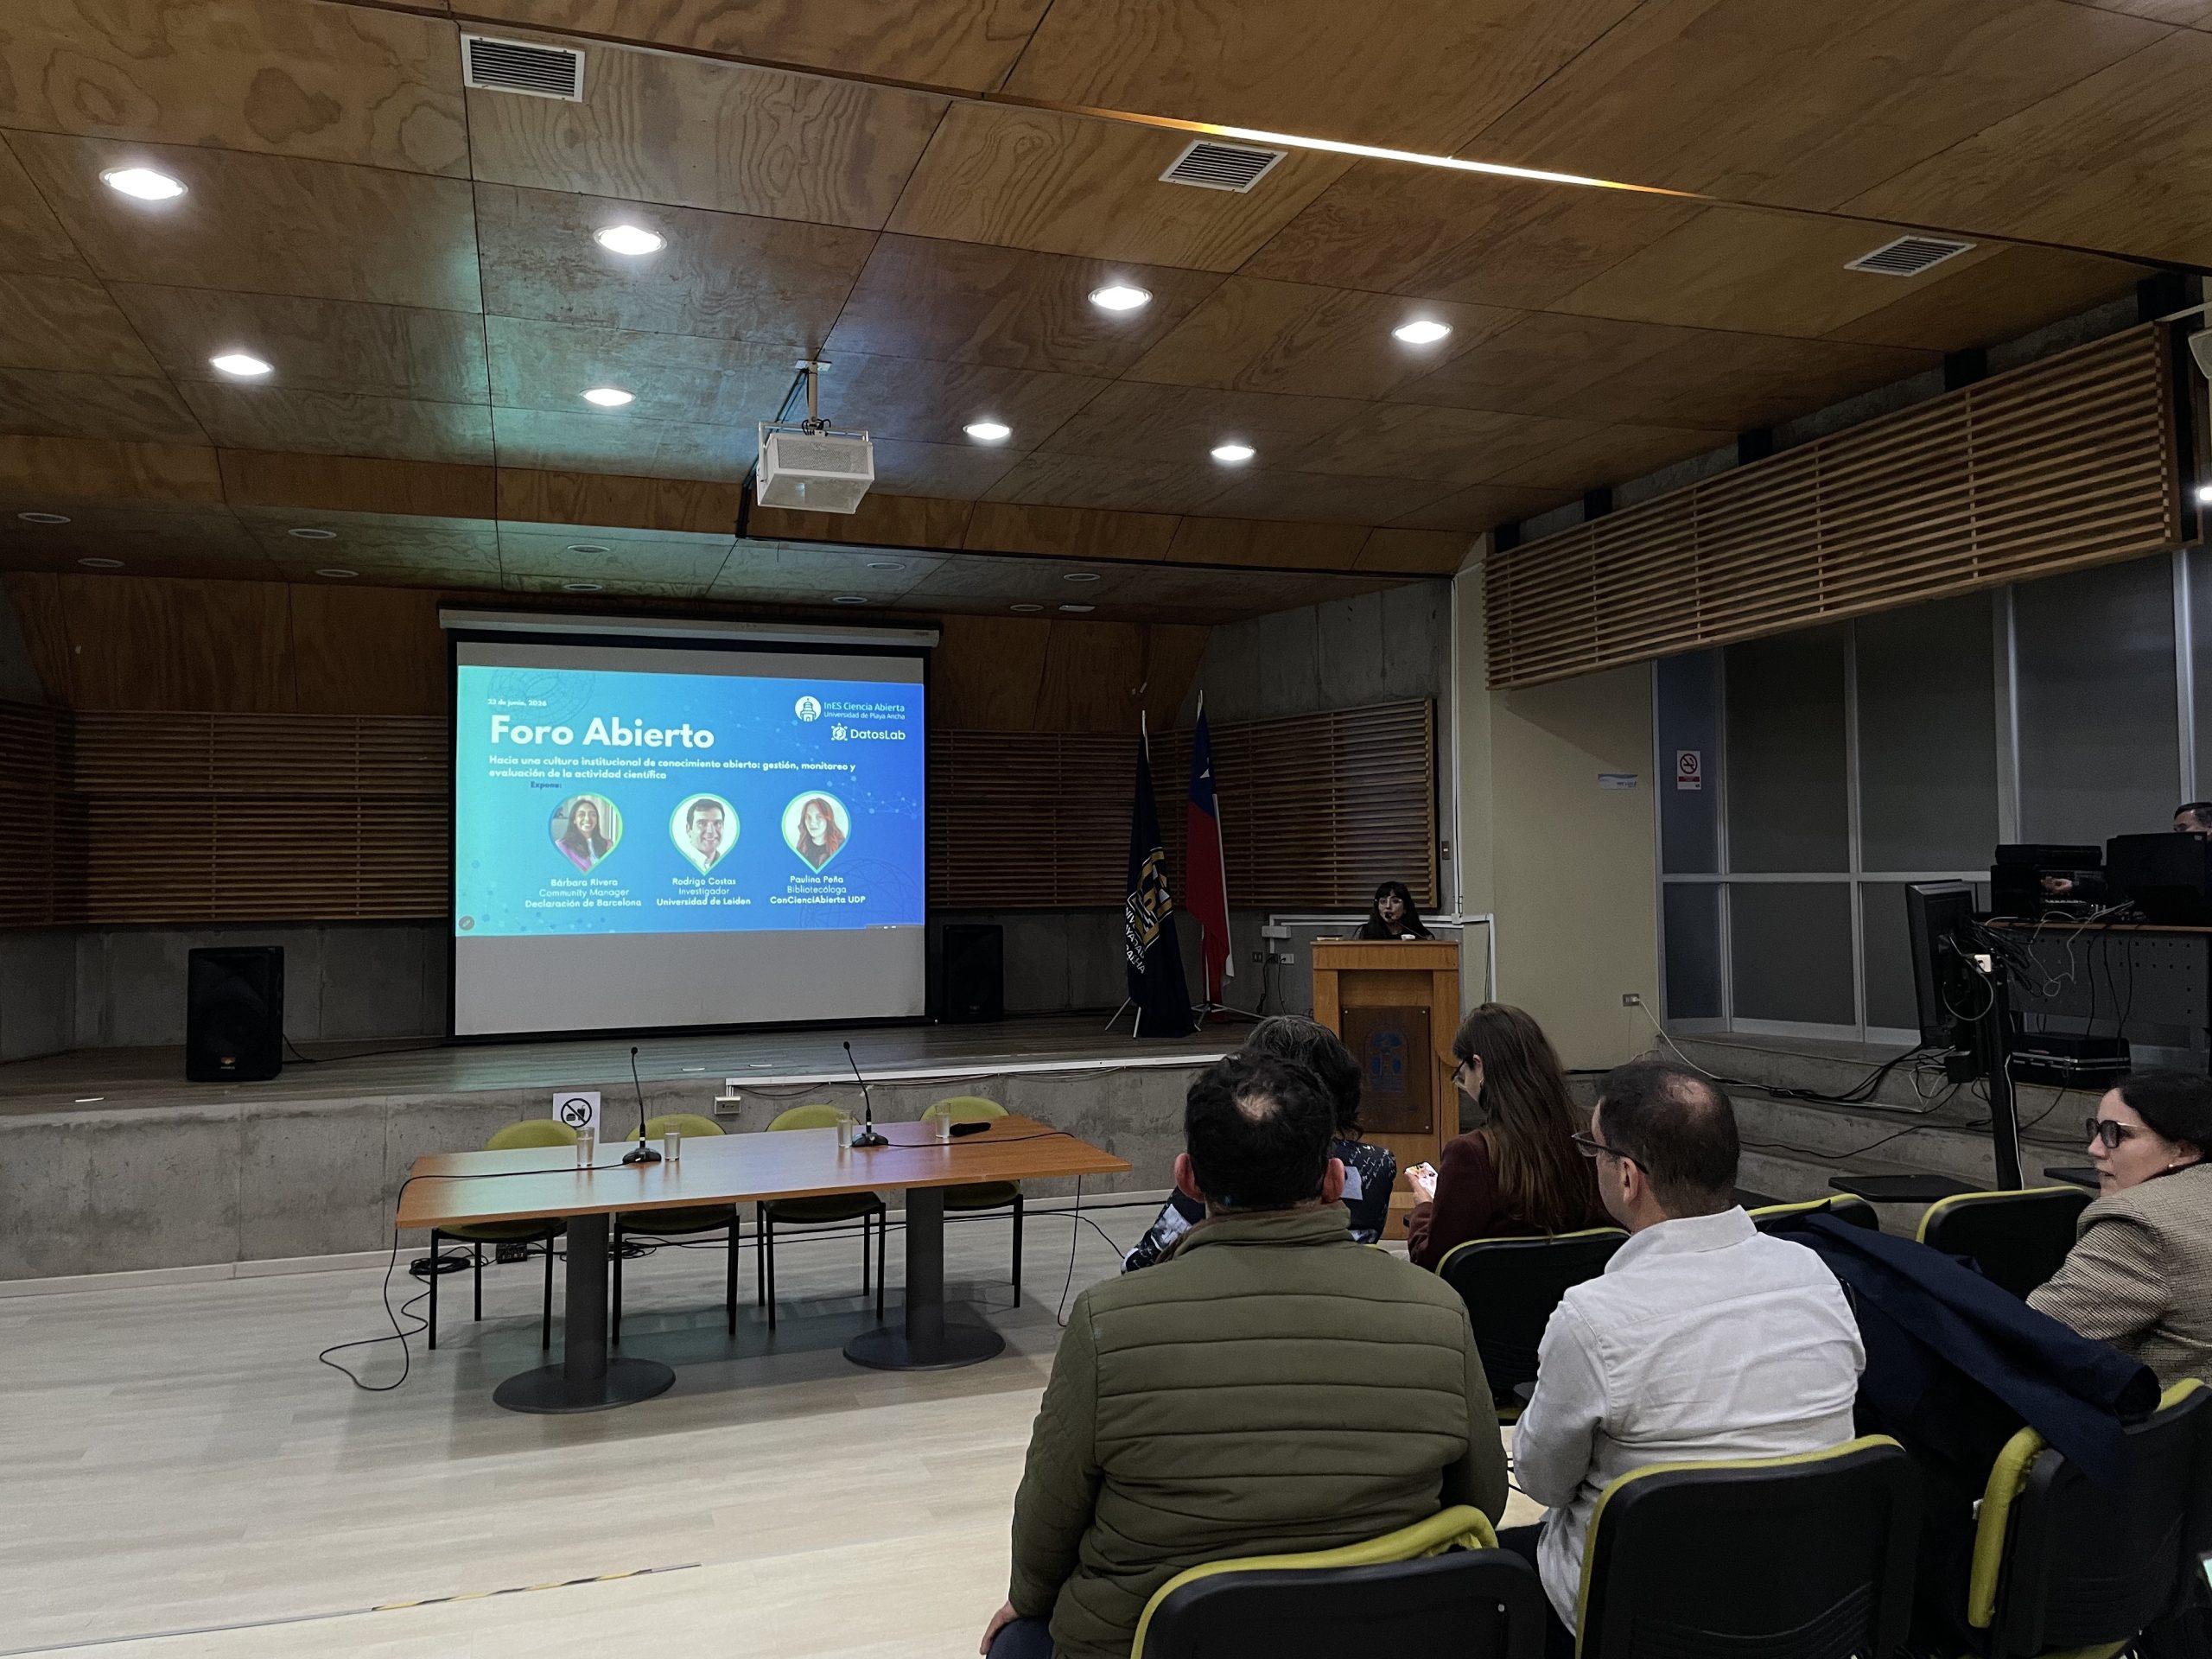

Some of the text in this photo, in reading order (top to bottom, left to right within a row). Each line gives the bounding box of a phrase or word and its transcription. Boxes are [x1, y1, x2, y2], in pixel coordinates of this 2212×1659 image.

[823, 702, 905, 712] InES Ciencia Abierta
[491, 715, 715, 748] Foro Abierto
[850, 728, 906, 740] DatosLab
[489, 755, 518, 765] Hacia
[543, 756, 579, 766] cultura
[582, 756, 641, 766] institucional
[643, 758, 655, 766] de
[658, 759, 721, 768] conocimiento
[723, 760, 760, 769] abierto:
[762, 760, 799, 771] gestión,
[801, 761, 848, 771] monitoreo
[850, 764, 855, 772] y
[489, 768, 666, 779] evaluación de la actividad científica
[550, 878, 618, 887] Bárbara Rivera
[672, 876, 706, 887] Rodrigo
[790, 874, 821, 883] Paulina
[539, 888, 629, 899] Community Manager
[678, 886, 730, 897] Investigador
[787, 884, 847, 895] Bibliotecóloga
[525, 898, 641, 908] Declaración de Barcelona
[656, 896, 751, 906] Universidad de Leiden
[770, 895, 846, 904] ConCienciAbierta
